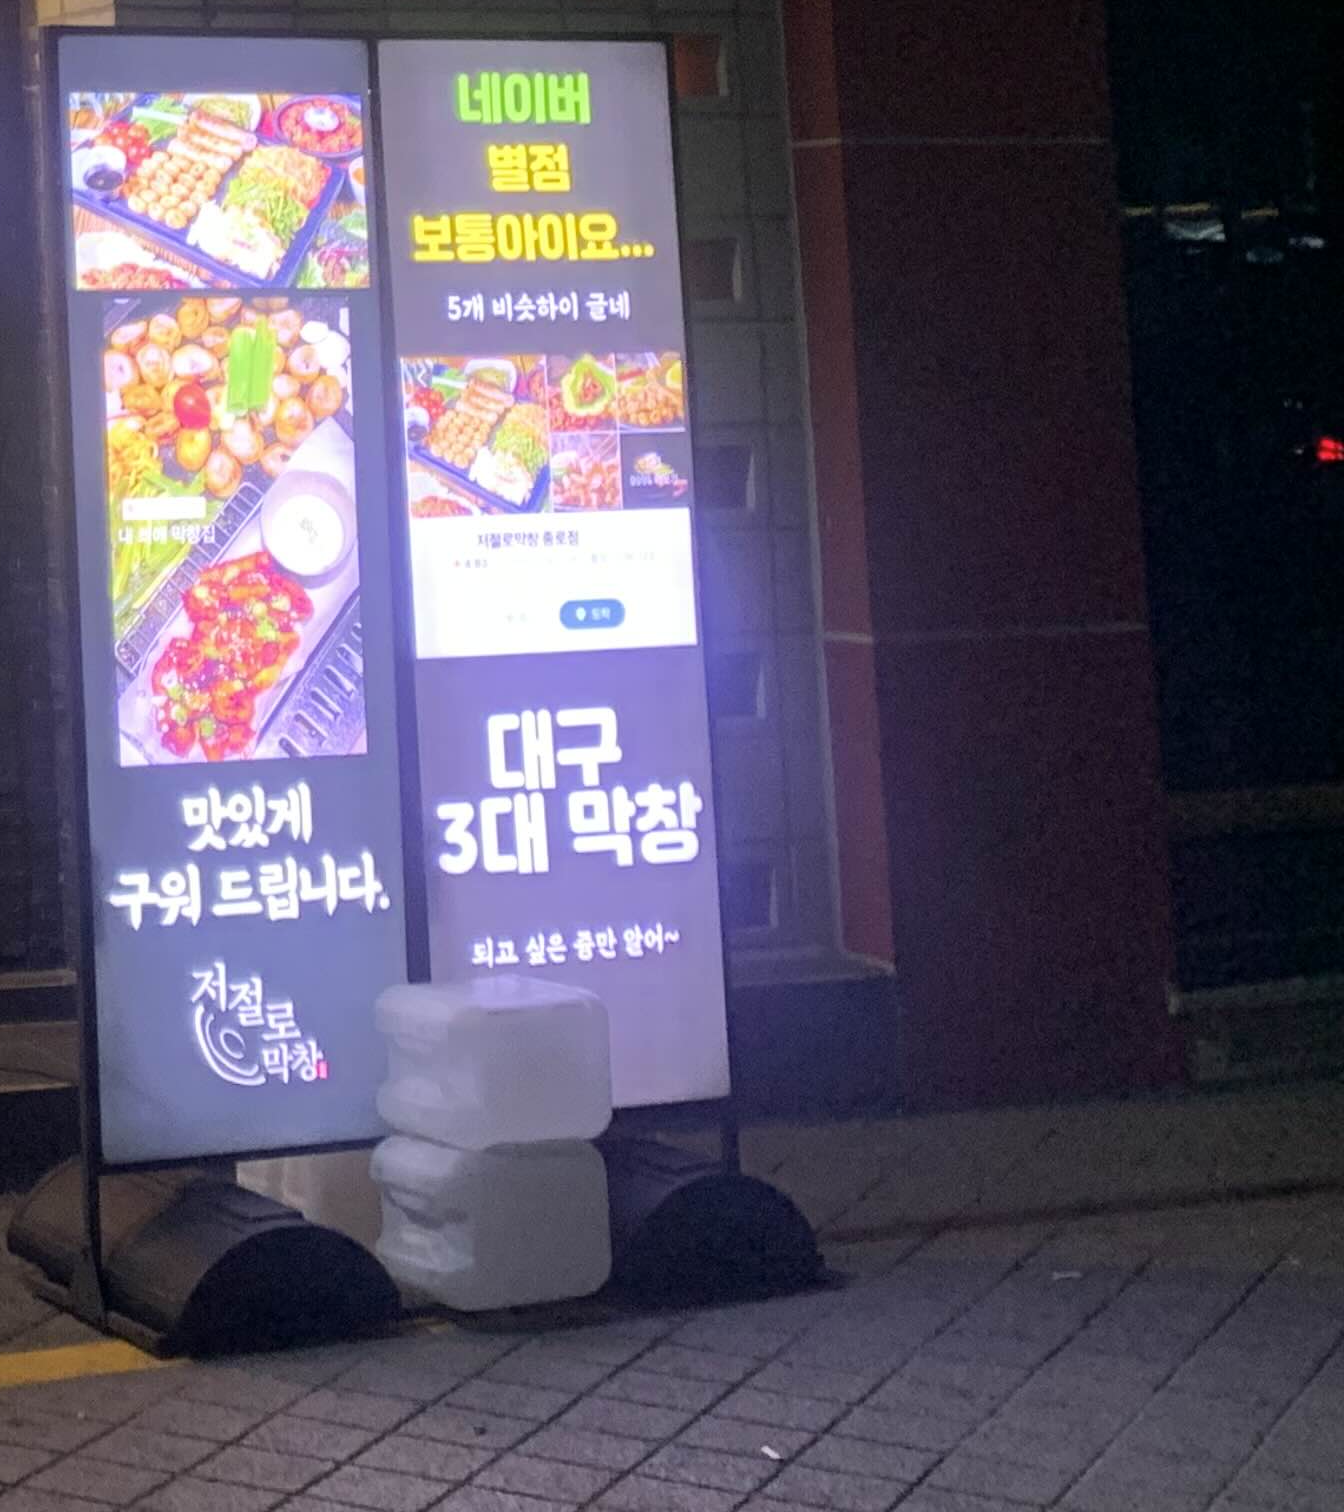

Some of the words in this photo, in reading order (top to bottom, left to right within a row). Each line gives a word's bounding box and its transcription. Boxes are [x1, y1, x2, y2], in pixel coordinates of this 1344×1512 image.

[455, 71, 592, 126] 네이버
[488, 143, 571, 193] 별점
[447, 295, 485, 323] 5개
[492, 292, 579, 322] 비슷하이
[486, 706, 623, 790] 대구
[181, 781, 313, 851] 맛있게
[436, 791, 550, 876] 3대
[566, 780, 703, 868] 막창
[108, 862, 202, 931] 구워
[211, 850, 391, 921] 드립니다.
[190, 961, 302, 1041] 저절로
[261, 1038, 323, 1085] 막창
